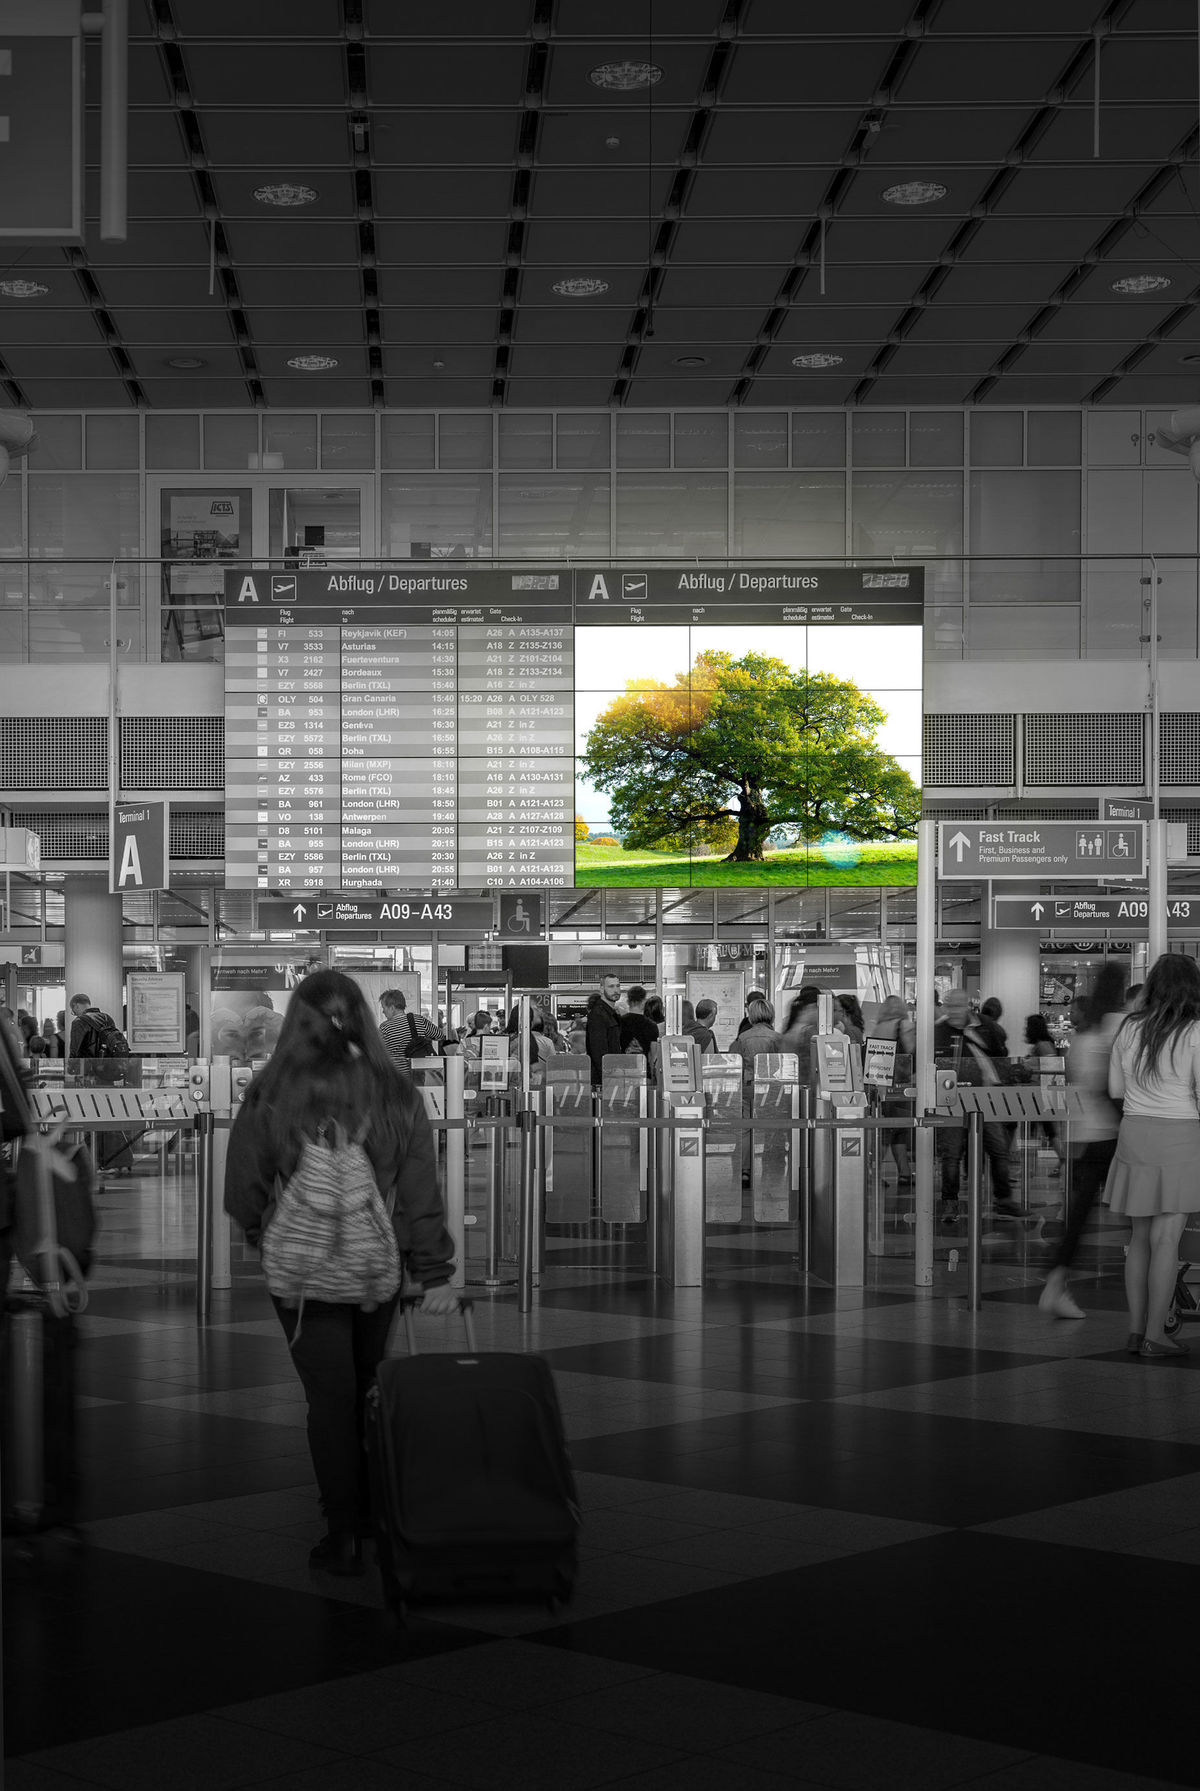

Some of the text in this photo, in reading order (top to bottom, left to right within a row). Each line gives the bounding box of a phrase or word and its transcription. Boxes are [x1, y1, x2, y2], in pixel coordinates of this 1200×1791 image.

[328, 575, 468, 594] Abflug / Departures
[588, 575, 609, 599] A
[678, 573, 818, 592] Abflug / Departures
[238, 576, 259, 602] A
[278, 630, 286, 638] FI
[308, 630, 323, 638] 533
[342, 629, 381, 639] Reykjavik
[384, 629, 407, 639] (KEF)
[432, 629, 454, 637] 14:05
[508, 629, 515, 637] A
[520, 628, 563, 636] A135-A137
[278, 641, 563, 650] V7 3533 Asturias 14:15 A18 Z Z135-Z136
[278, 668, 562, 677] V7 2427 Bordeaux 15:30 A18 Z Z133-Z134
[278, 695, 296, 703] OLY
[309, 695, 323, 703] 504
[342, 695, 362, 703] Gran
[364, 695, 396, 703] Canaria
[432, 694, 454, 702] 15:40
[461, 695, 482, 703] 15:20
[509, 694, 515, 702] A
[520, 694, 538, 702] OLY
[540, 694, 555, 702] 528
[278, 721, 295, 729] EZS
[304, 721, 323, 729] 1314
[432, 720, 455, 728] 16:30
[487, 720, 501, 728] A21
[509, 720, 514, 728] Z
[520, 720, 527, 728] in
[529, 720, 535, 728] Z
[278, 747, 291, 755] QR
[308, 747, 323, 755] 058
[342, 747, 364, 755] Doha
[433, 747, 455, 755] 16:55
[487, 747, 503, 755] B15
[508, 746, 515, 754] A
[278, 774, 290, 782] AZ
[309, 774, 323, 782] 433
[342, 774, 366, 782] Rome
[368, 774, 392, 783] (FCO)
[432, 773, 454, 781] 18:10
[509, 773, 516, 781] A
[520, 773, 563, 781] A130-A131
[279, 799, 564, 809] BA 961 London (LHR) 18:50 B01 A A121-A123
[1109, 804, 1140, 818] Terminal 1
[118, 809, 150, 824] Terminal 1
[278, 813, 291, 821] VO
[309, 813, 323, 821] 138
[342, 813, 386, 822] Antwerpen
[432, 812, 455, 820] 19:40
[509, 812, 515, 820] A
[279, 826, 562, 836] D8 5101 Malaga 20:05 A21 Z Z107-Z109
[979, 831, 1040, 842] Fast Track
[979, 846, 1045, 854] First, Business and
[118, 835, 143, 887] A
[278, 853, 295, 861] EZY
[304, 853, 324, 861] 5586
[342, 852, 367, 860] Berlin
[369, 852, 391, 862] (TXL)
[432, 852, 454, 860] 20:30
[509, 852, 514, 860] Z
[520, 852, 528, 860] in
[529, 852, 535, 860] Z
[1012, 855, 1052, 864] Passengers
[1053, 855, 1068, 864] only
[278, 878, 291, 886] XR
[304, 878, 323, 886] 5918
[342, 878, 382, 888] Hurghada
[432, 878, 454, 886] 21:40
[487, 878, 503, 886] C10
[509, 878, 516, 886] A
[336, 904, 358, 912] Abflug
[1074, 902, 1096, 910] Abflug
[335, 912, 372, 920] Departures
[1073, 910, 1110, 919] Departures
